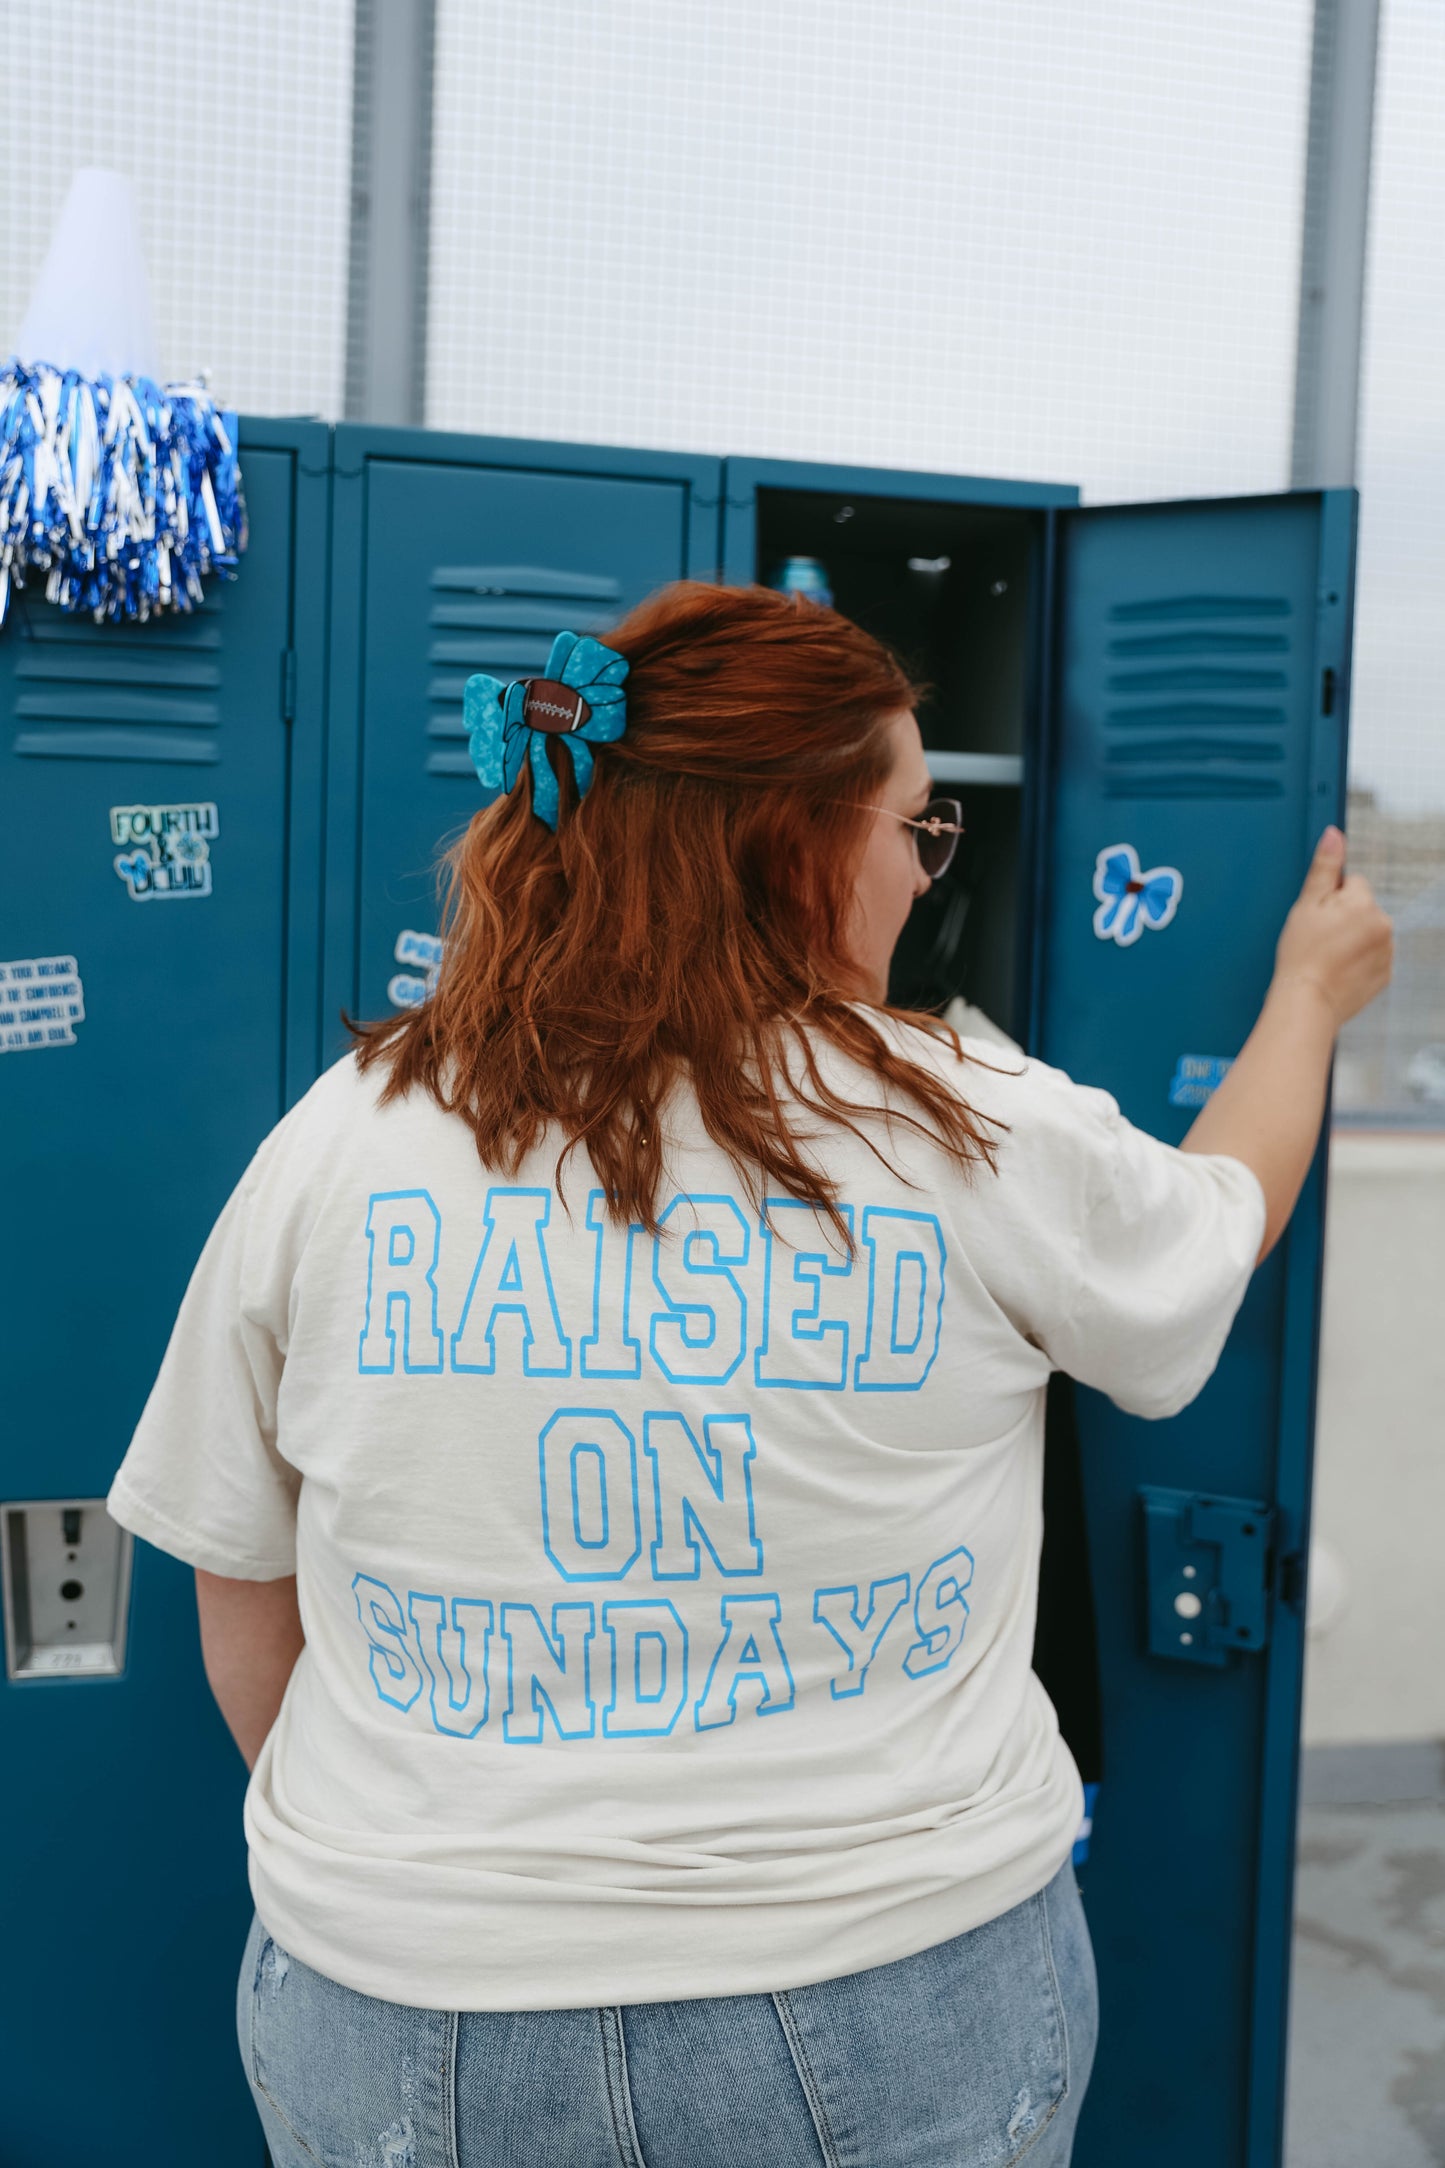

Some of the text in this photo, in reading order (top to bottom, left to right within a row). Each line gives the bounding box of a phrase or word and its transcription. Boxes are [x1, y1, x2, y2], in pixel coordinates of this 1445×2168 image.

[116, 808, 211, 837] FOURTH
[358, 1186, 948, 1392] RAISED
[538, 1407, 764, 1583] ON
[351, 1545, 975, 1745] SUNDAYS
